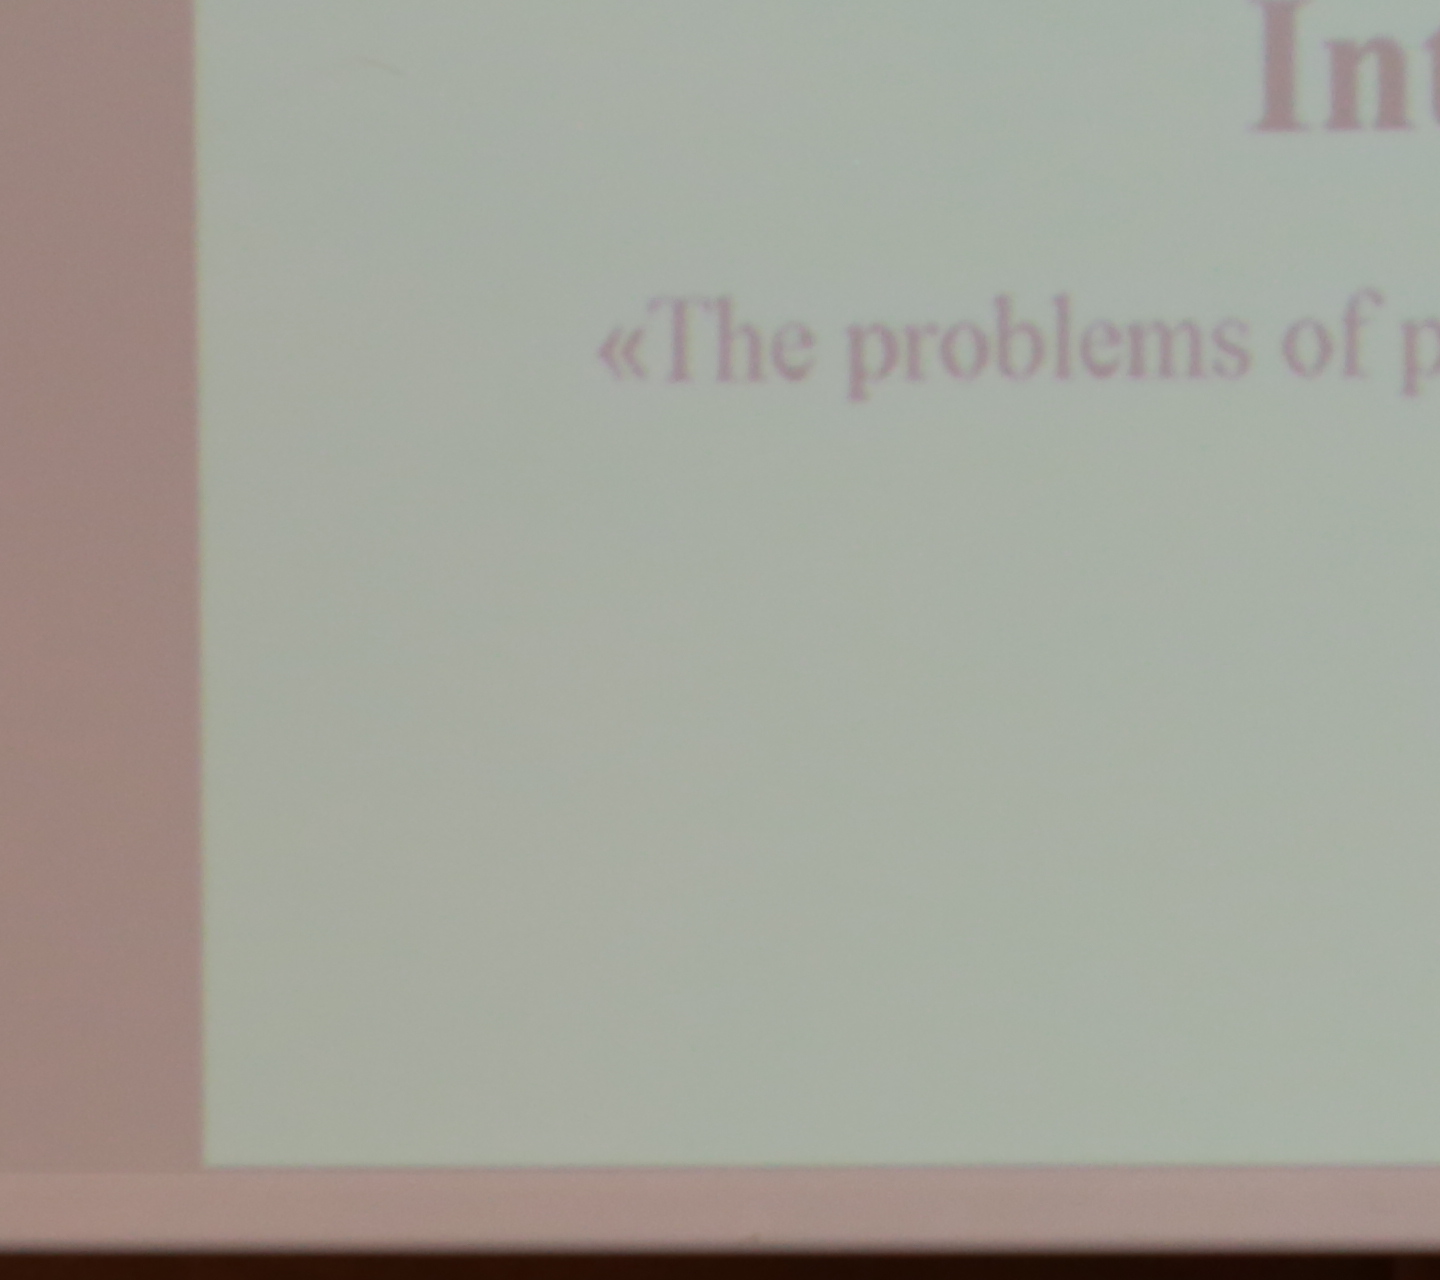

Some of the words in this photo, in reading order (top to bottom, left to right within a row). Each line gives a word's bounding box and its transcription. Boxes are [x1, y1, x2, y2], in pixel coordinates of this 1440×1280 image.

[596, 295, 815, 384] «The
[846, 291, 1252, 404] problems
[1280, 286, 1385, 382] of
